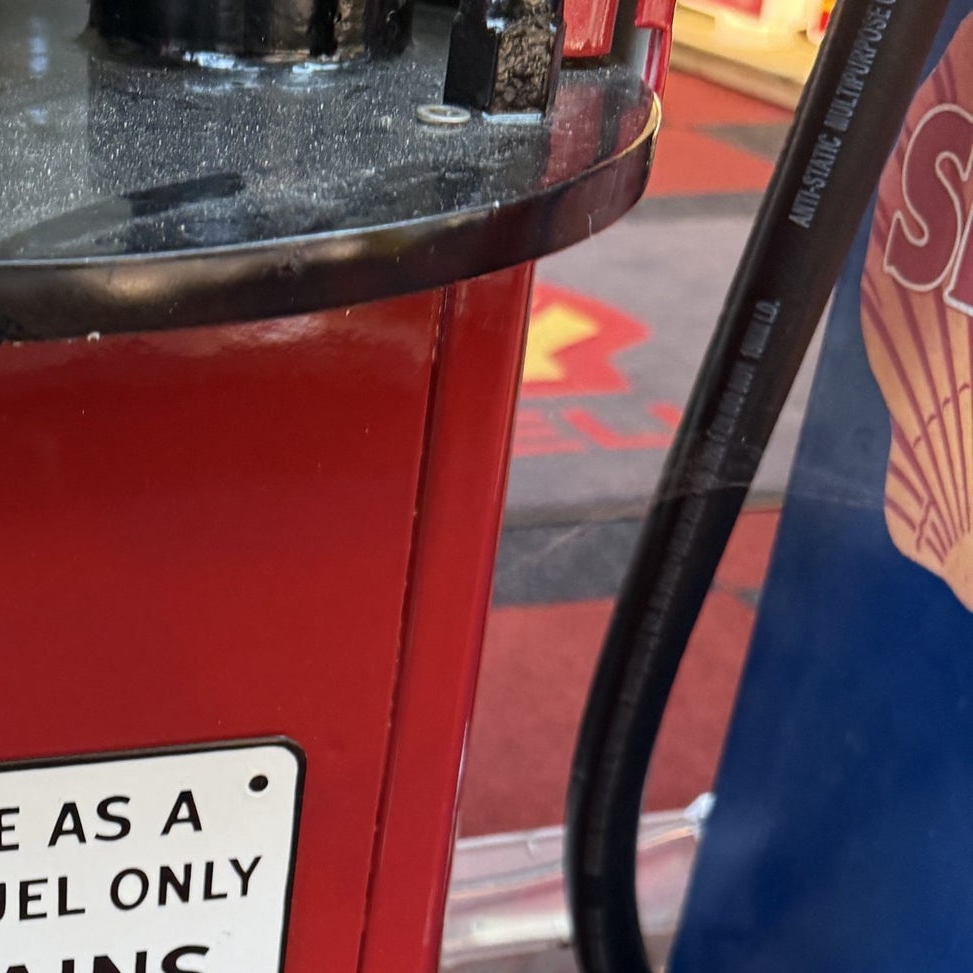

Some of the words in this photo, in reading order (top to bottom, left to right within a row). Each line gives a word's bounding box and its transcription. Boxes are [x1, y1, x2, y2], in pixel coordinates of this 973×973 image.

[788, 133, 842, 229] ANTI-STATIC
[824, 8, 892, 132] MULTIPURPOSE
[882, 103, 973, 316] S
[48, 796, 131, 847] AS
[160, 790, 203, 836] A
[109, 856, 263, 911] ONLY
